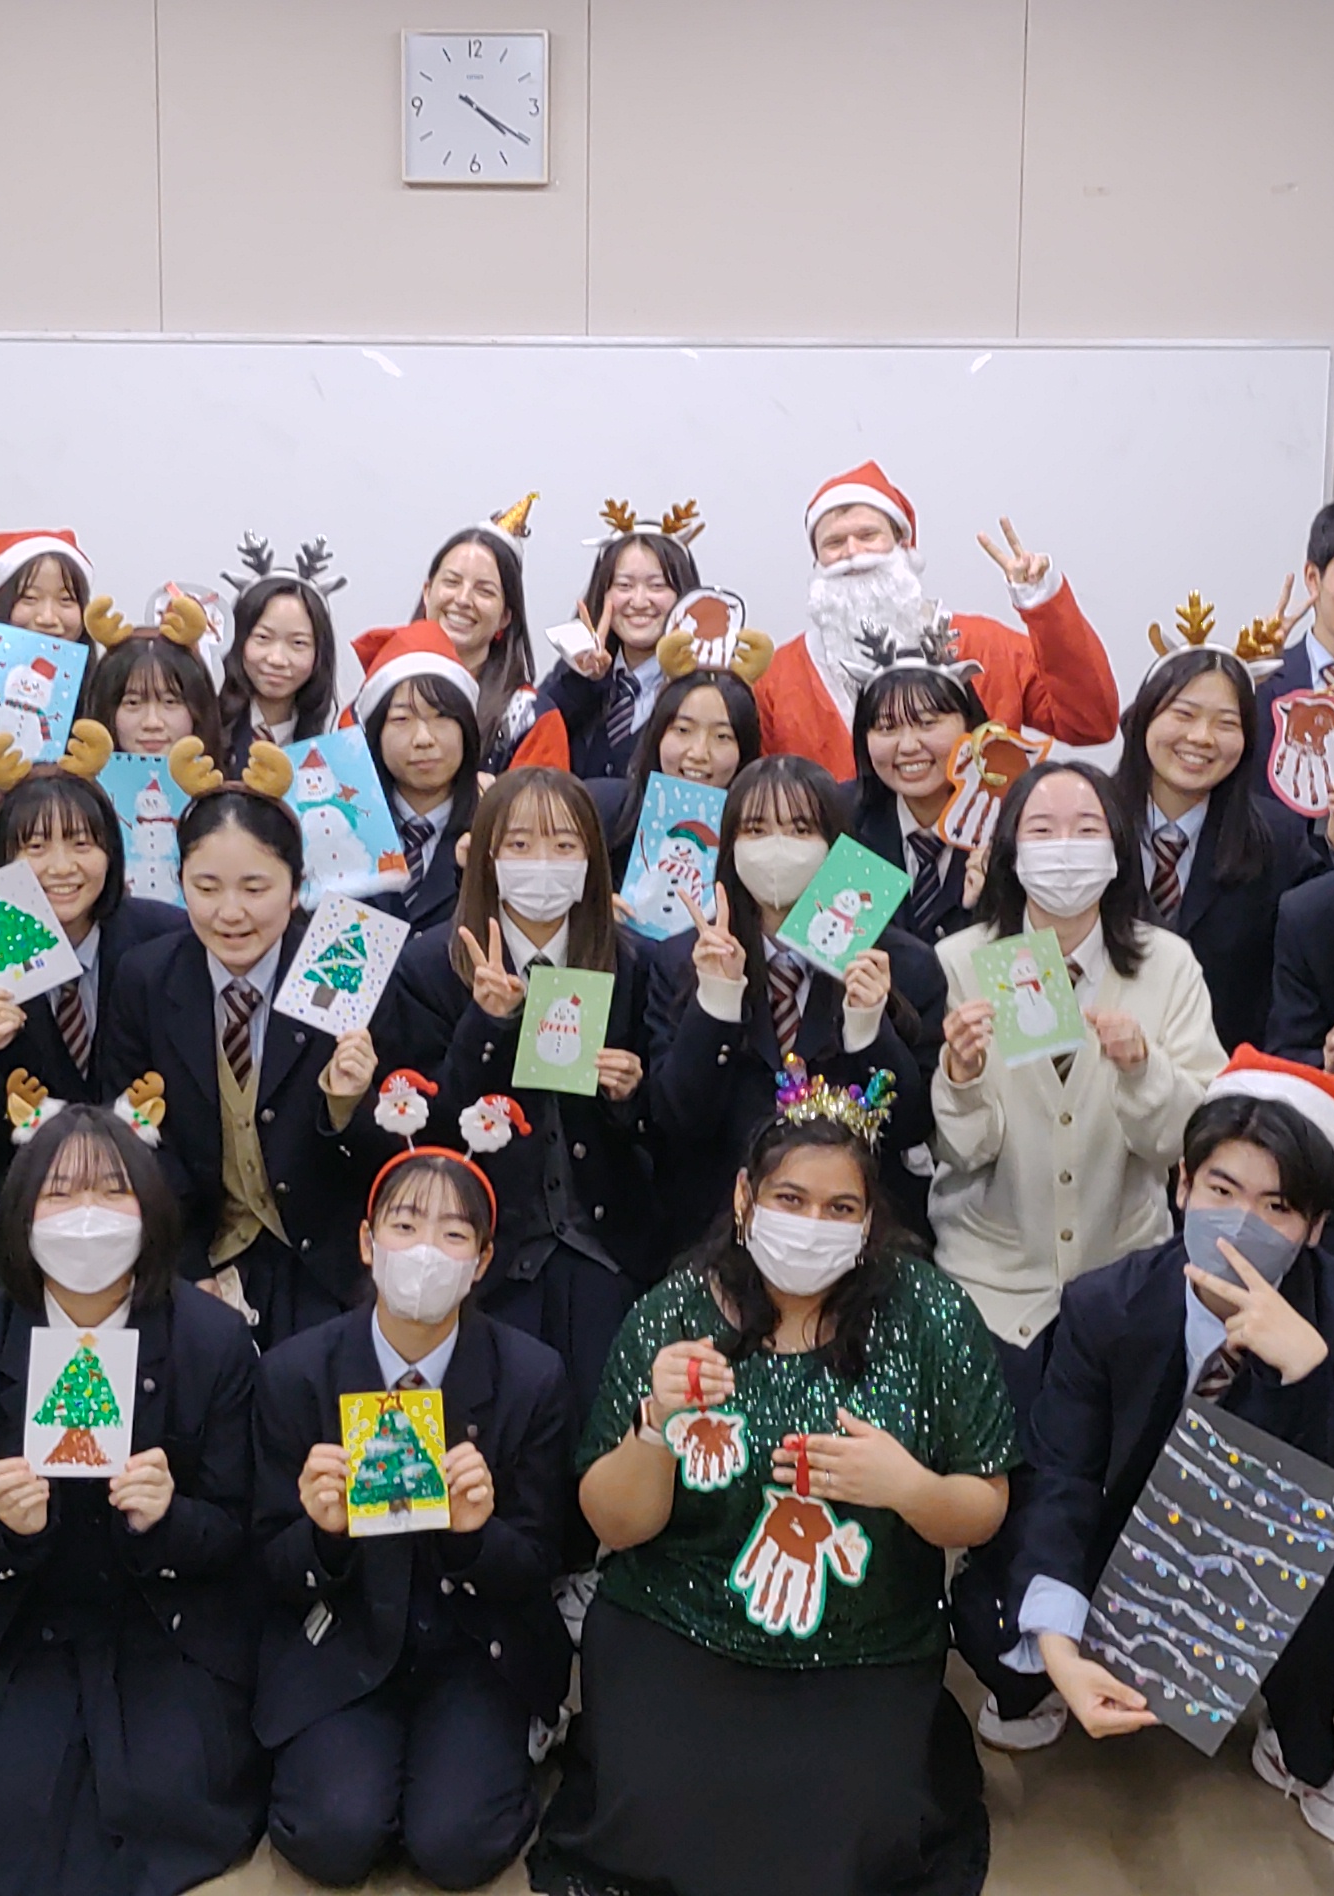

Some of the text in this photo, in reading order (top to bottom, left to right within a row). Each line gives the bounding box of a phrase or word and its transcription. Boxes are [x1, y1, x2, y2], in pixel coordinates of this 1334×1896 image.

[468, 39, 483, 59] 12
[411, 96, 423, 117] 9
[528, 98, 540, 117] 3
[469, 153, 482, 174] 6
